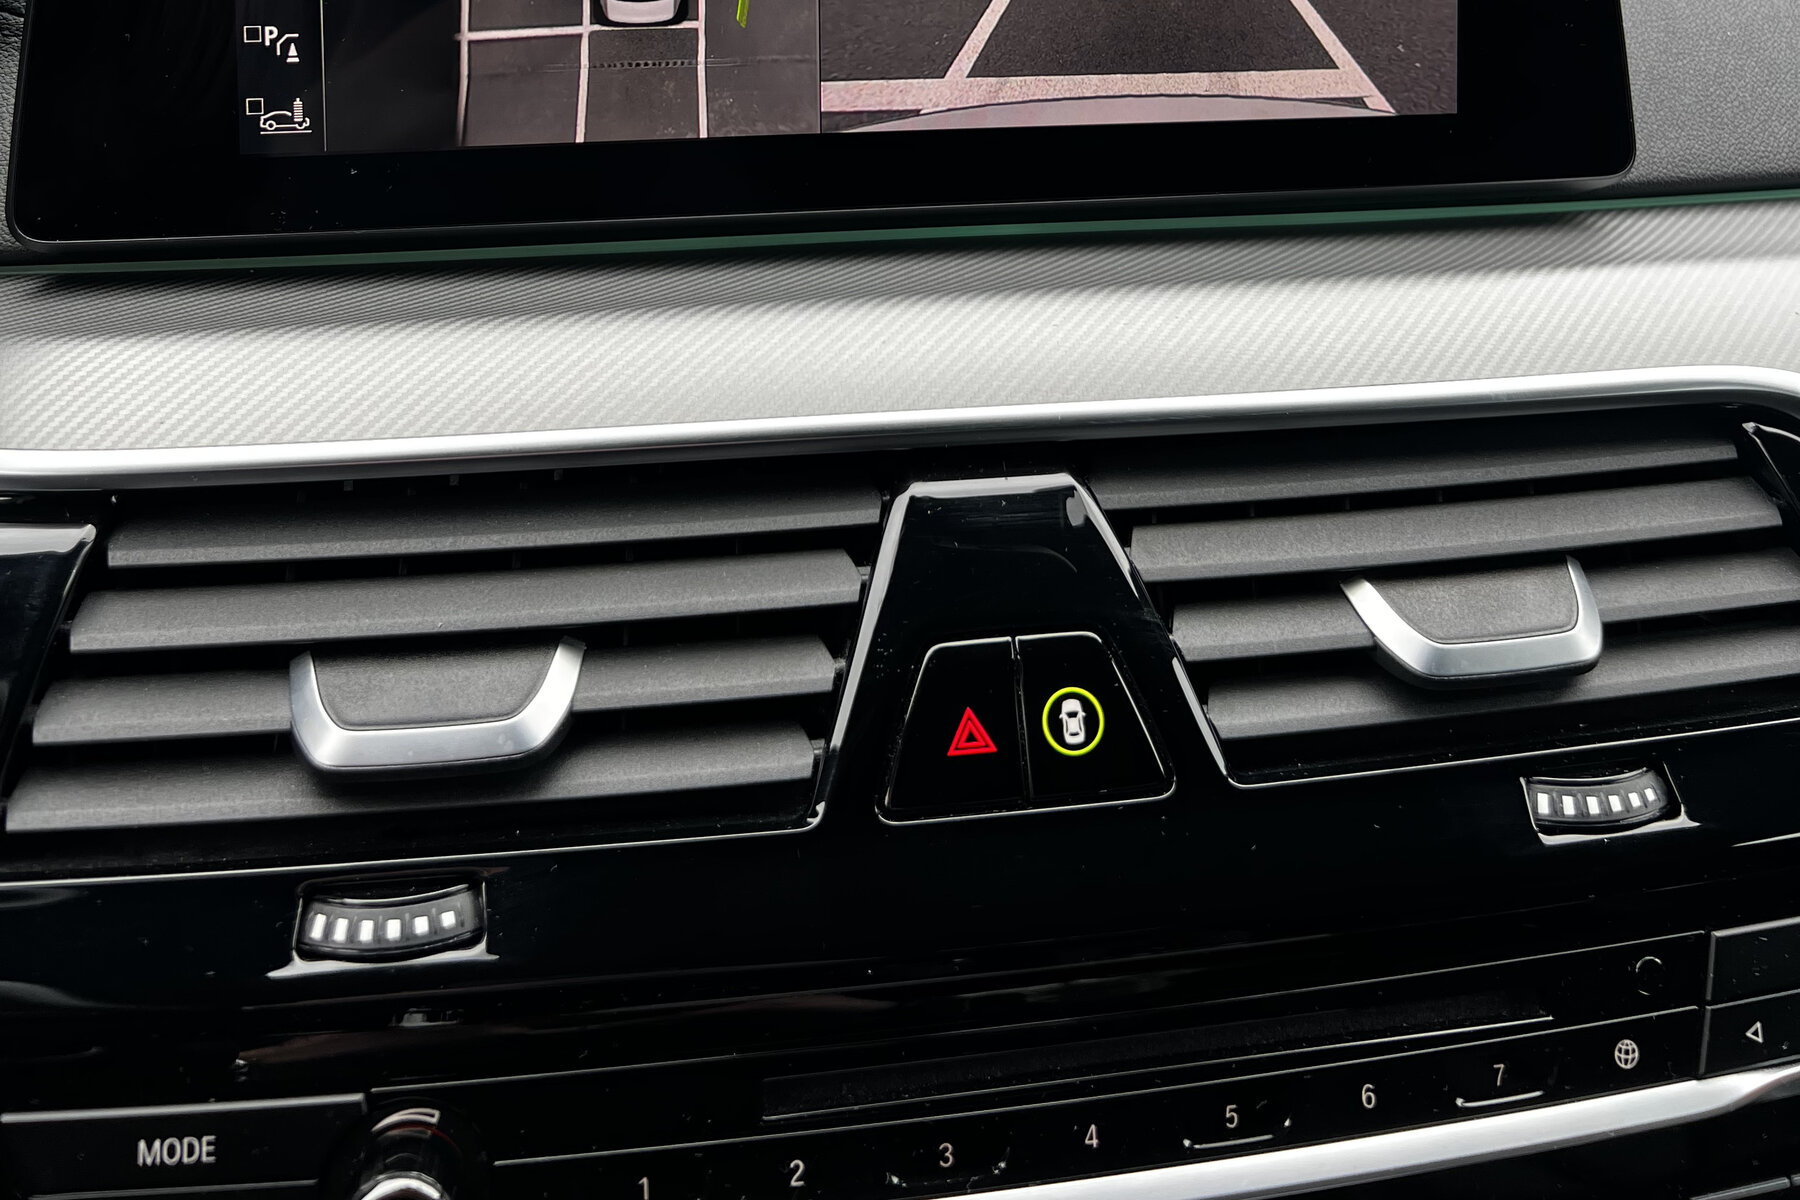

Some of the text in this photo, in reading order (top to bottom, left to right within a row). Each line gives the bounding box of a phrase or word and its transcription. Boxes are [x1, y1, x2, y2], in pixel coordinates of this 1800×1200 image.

[264, 26, 279, 47] P
[1493, 1063, 1505, 1087] 7
[1361, 1083, 1376, 1109] 6
[1225, 1104, 1238, 1129] 5
[1084, 1123, 1099, 1149] 4
[137, 1135, 216, 1167] MODE
[938, 1142, 954, 1169] 3
[789, 1159, 805, 1187] 2
[638, 1176, 649, 1200] 1
